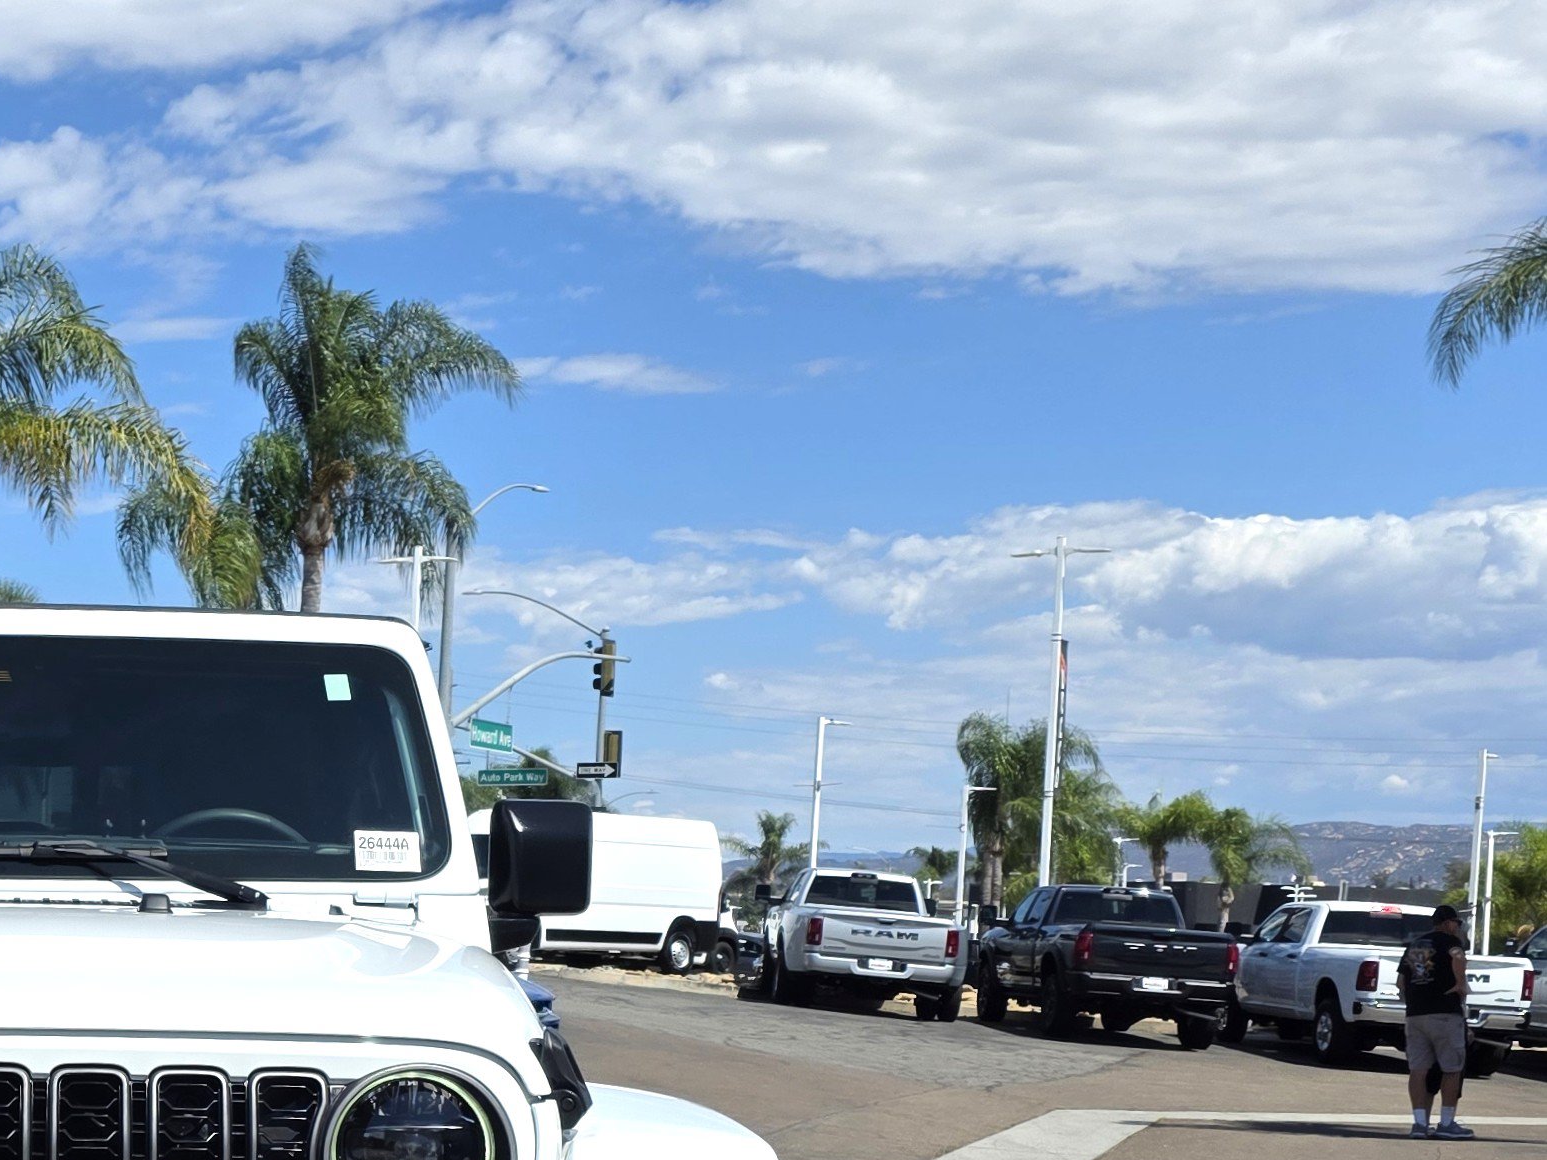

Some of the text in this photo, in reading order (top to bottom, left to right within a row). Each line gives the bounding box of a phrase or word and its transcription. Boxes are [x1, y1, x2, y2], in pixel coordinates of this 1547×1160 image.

[472, 725, 512, 748] Howard Ave
[479, 772, 545, 783] Auto Park Way
[358, 836, 409, 851] 26444A
[851, 929, 919, 941] RAM
